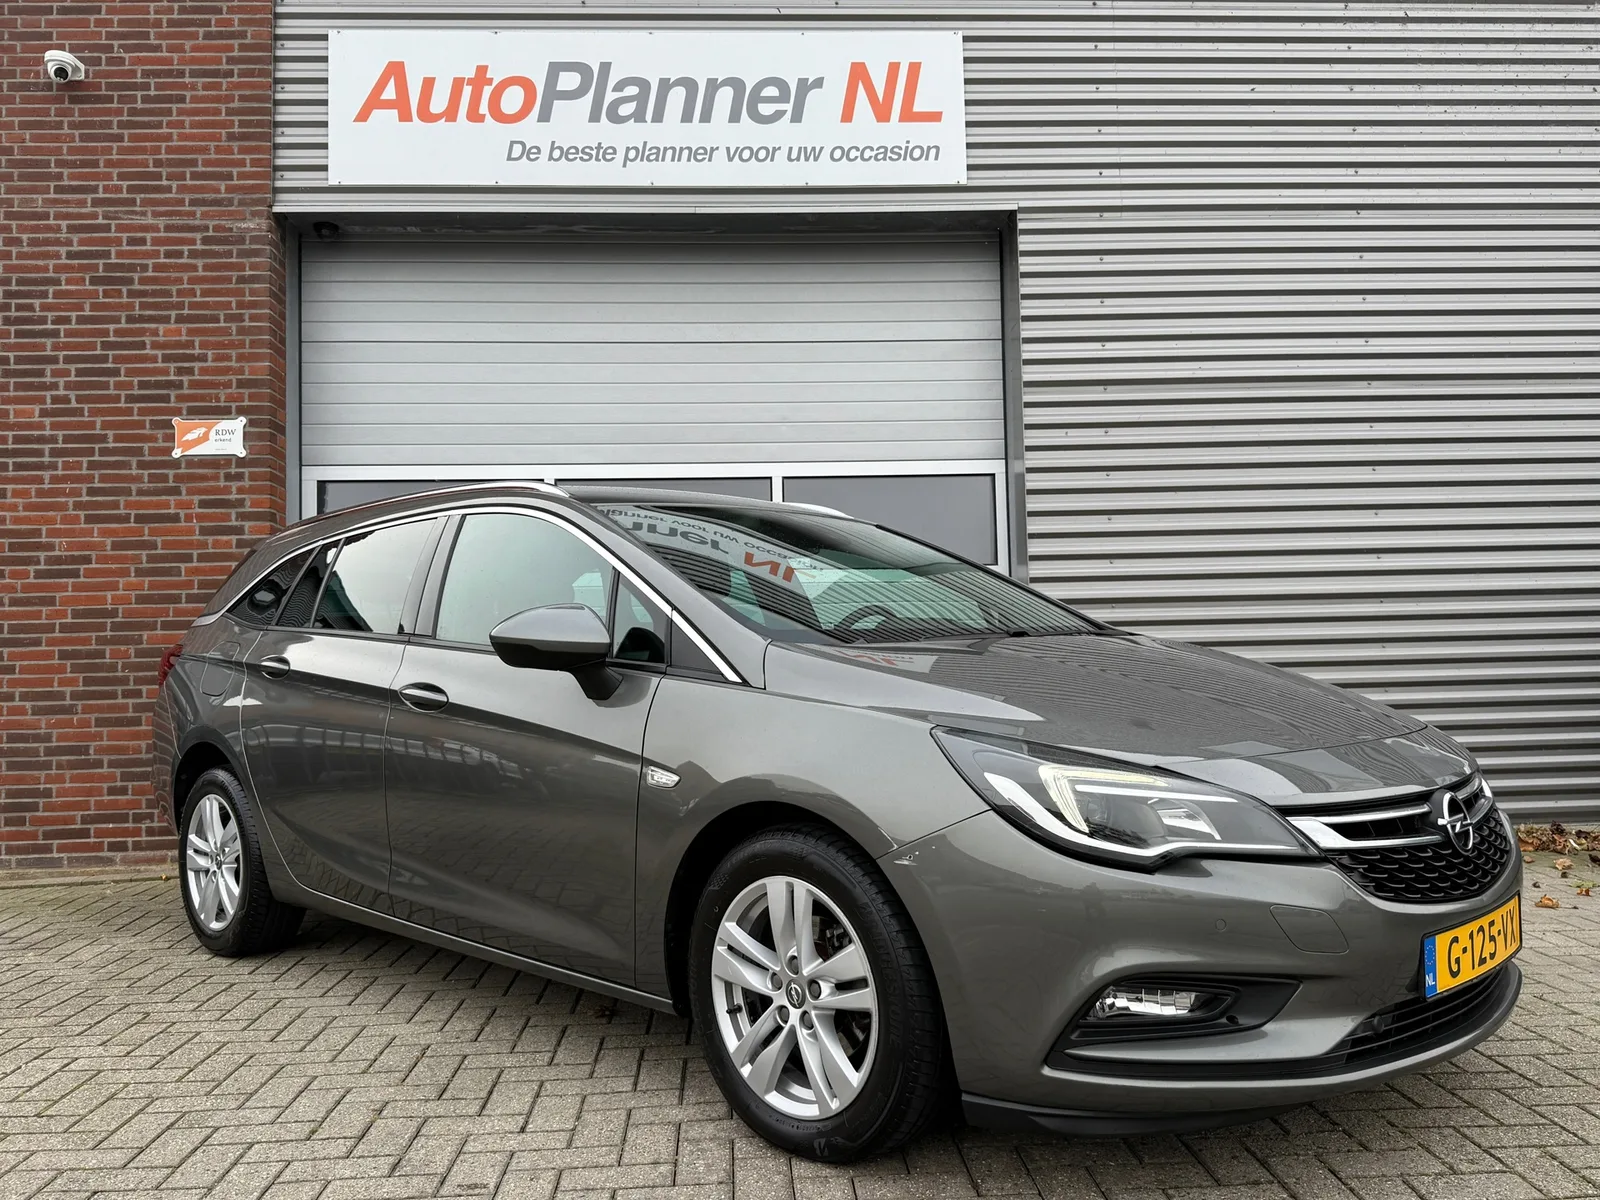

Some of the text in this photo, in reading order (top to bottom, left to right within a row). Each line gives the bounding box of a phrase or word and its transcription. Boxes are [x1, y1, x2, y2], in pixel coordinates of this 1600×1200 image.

[353, 61, 943, 125] AutoPlanner NL
[506, 140, 940, 168] De beste planner voor uw occasion
[1447, 906, 1516, 979] G-125-VX
[1425, 973, 1435, 987] NL
